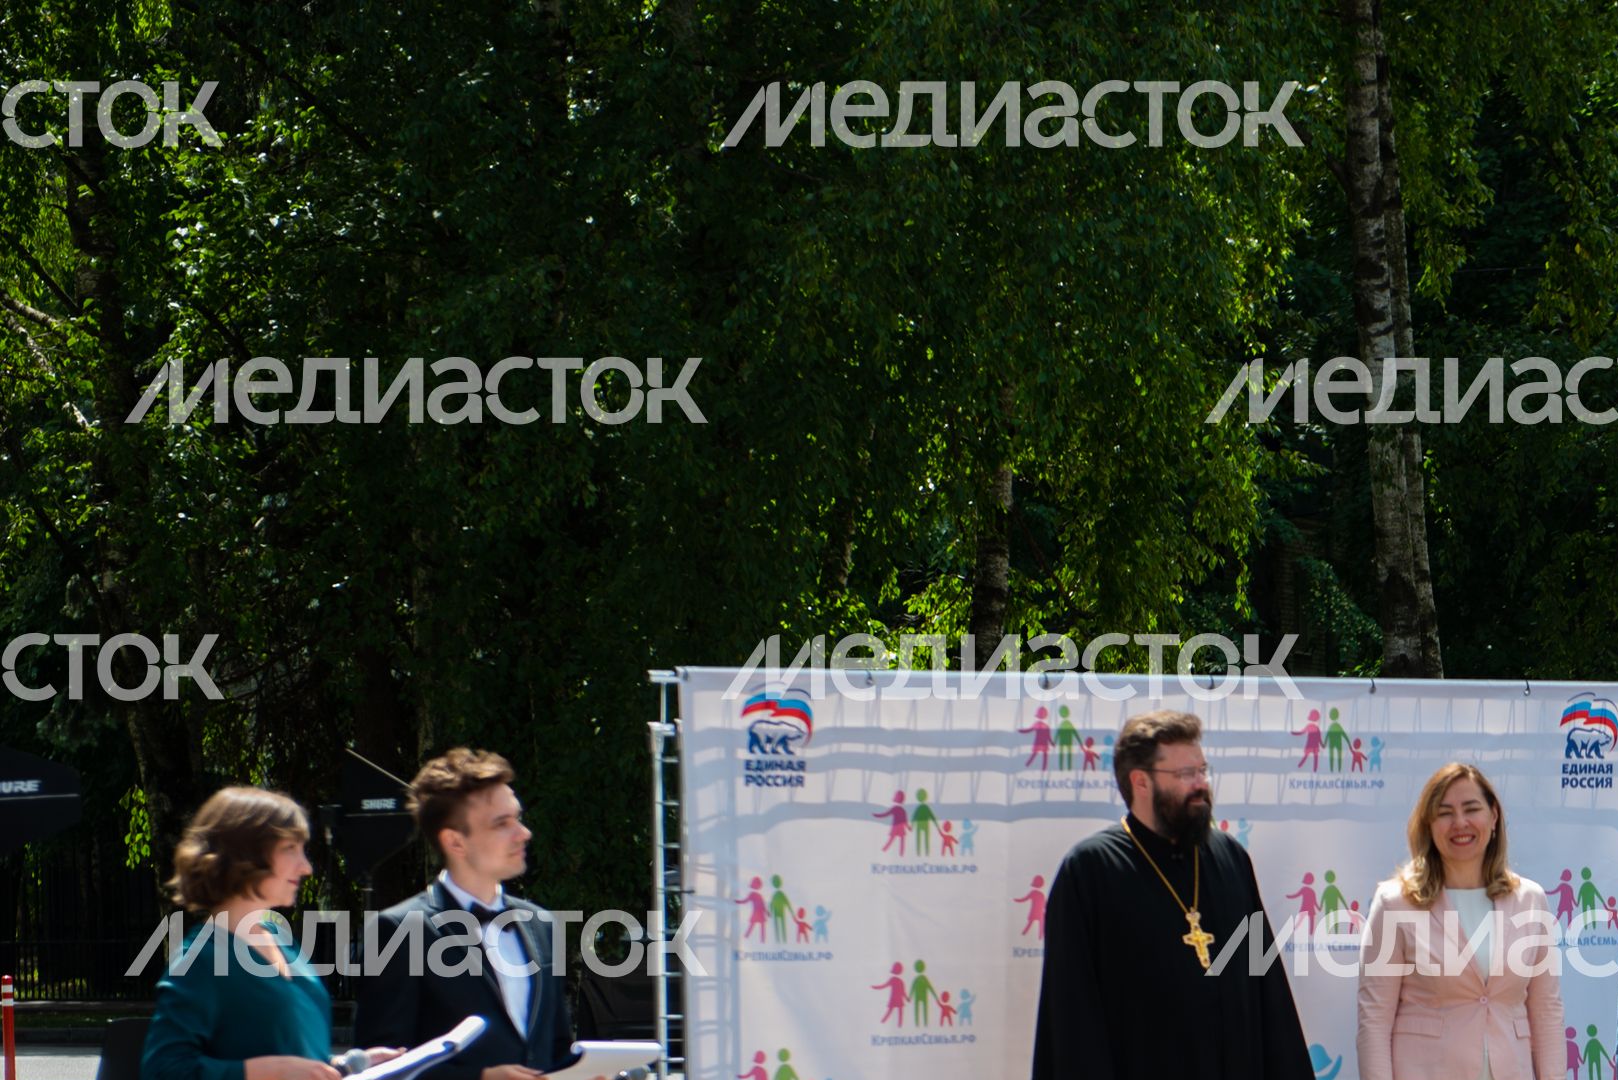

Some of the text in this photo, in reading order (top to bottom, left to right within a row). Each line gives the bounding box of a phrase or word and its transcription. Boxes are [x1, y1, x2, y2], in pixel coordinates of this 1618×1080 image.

[745, 760, 806, 771] ЕДИНАЯ
[1562, 763, 1613, 776] ЕДИНАЯ
[745, 775, 804, 787] РОССИЯ
[1561, 777, 1613, 788] РОССИЯ
[361, 798, 397, 809] SHURE
